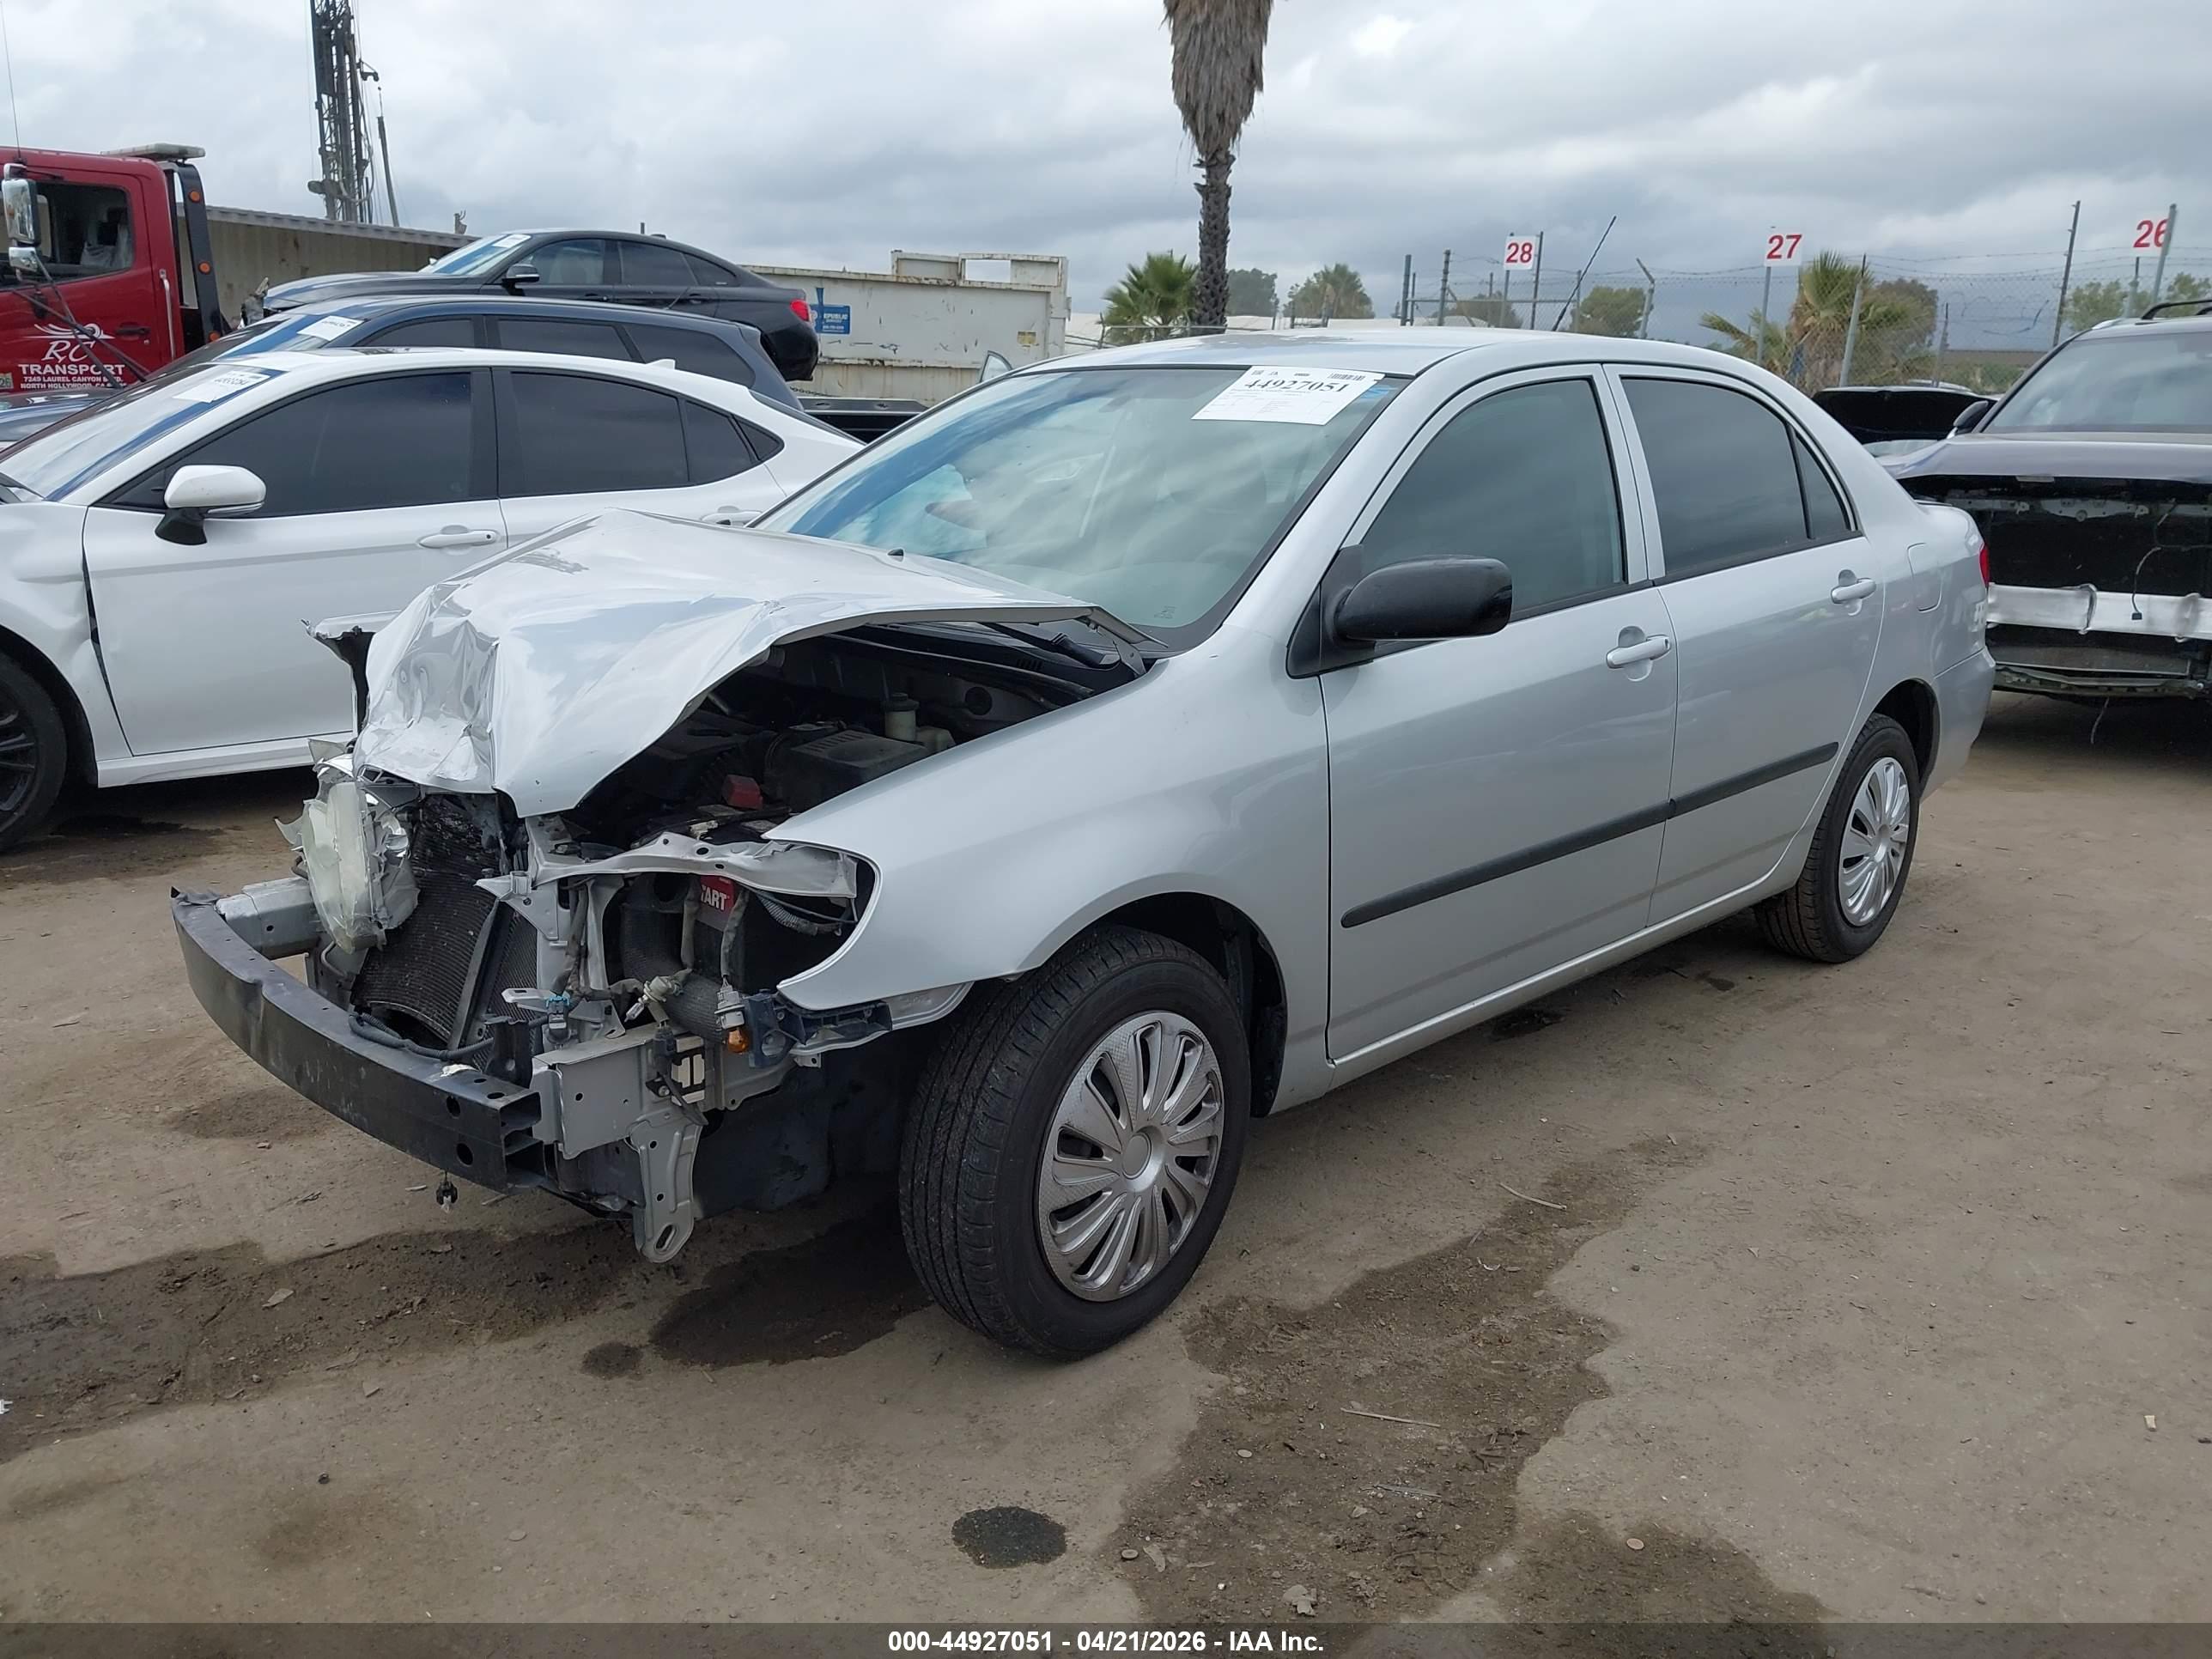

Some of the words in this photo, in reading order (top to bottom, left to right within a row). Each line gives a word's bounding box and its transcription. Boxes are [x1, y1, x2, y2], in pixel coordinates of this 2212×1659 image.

[2133, 217, 2172, 247] 26
[1505, 242, 1533, 264] 28
[1766, 234, 1802, 259] 27
[41, 340, 96, 363] RC
[1244, 379, 1349, 392] 44927051
